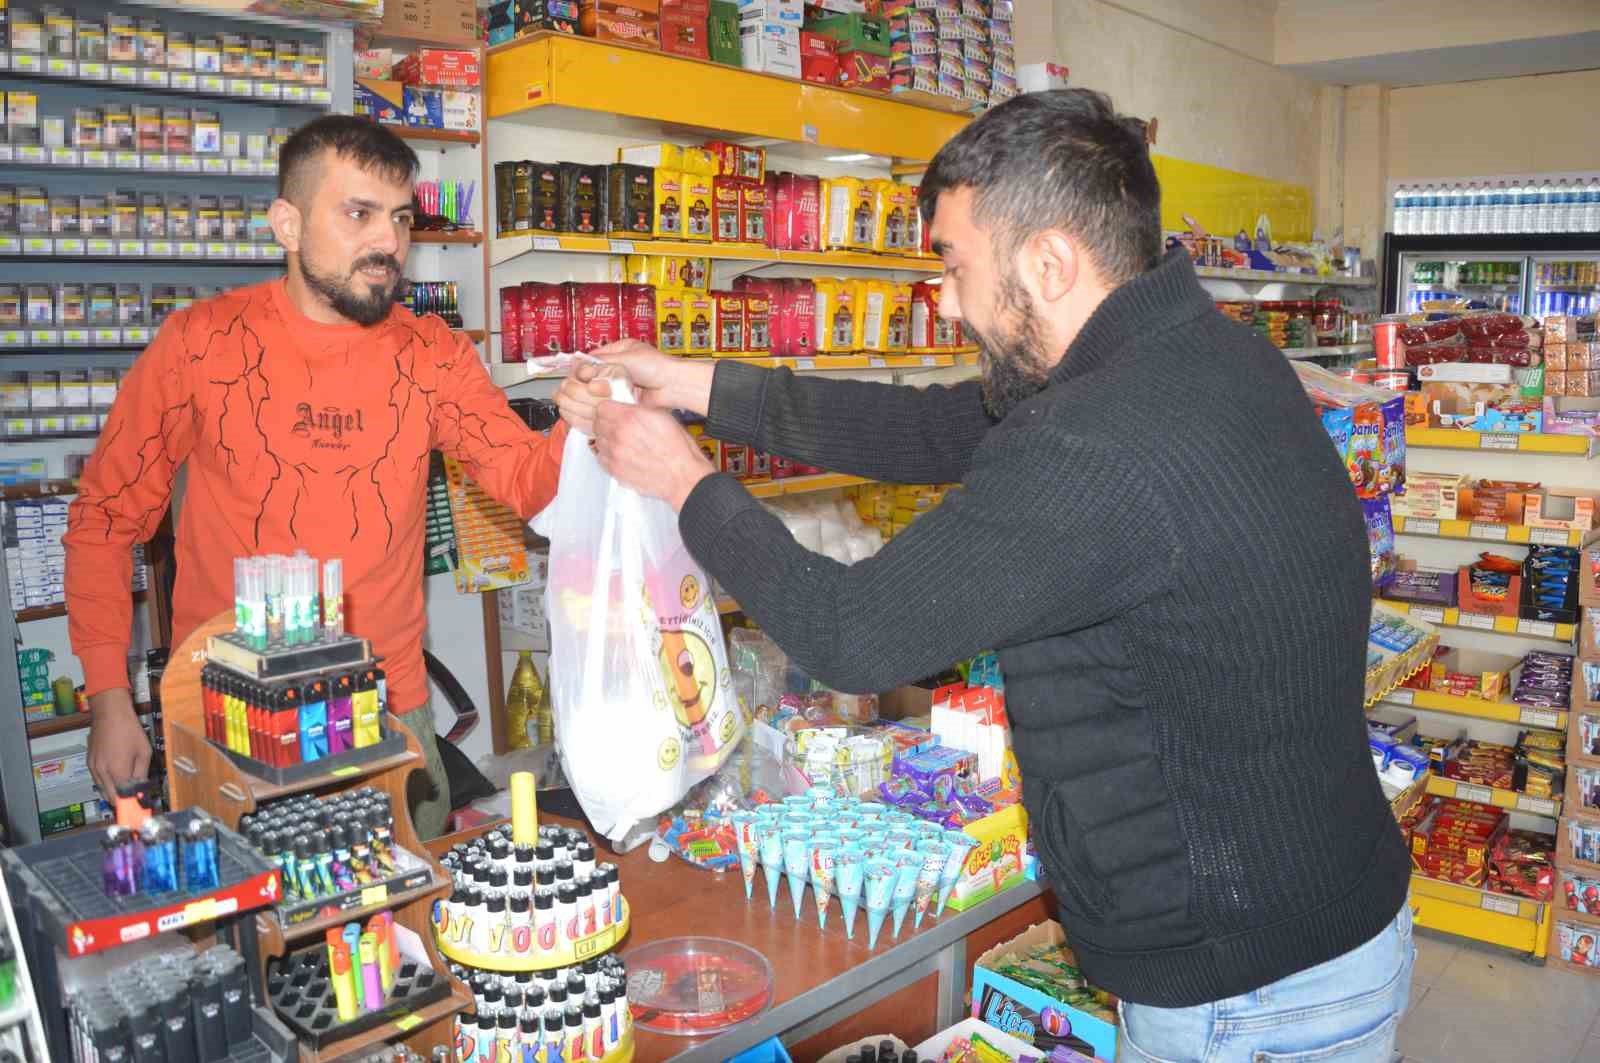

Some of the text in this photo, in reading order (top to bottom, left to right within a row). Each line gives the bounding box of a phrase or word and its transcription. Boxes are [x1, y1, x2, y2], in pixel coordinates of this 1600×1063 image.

[543, 304, 564, 319] filiz
[592, 303, 616, 319] filiz
[289, 402, 364, 438] Angel
